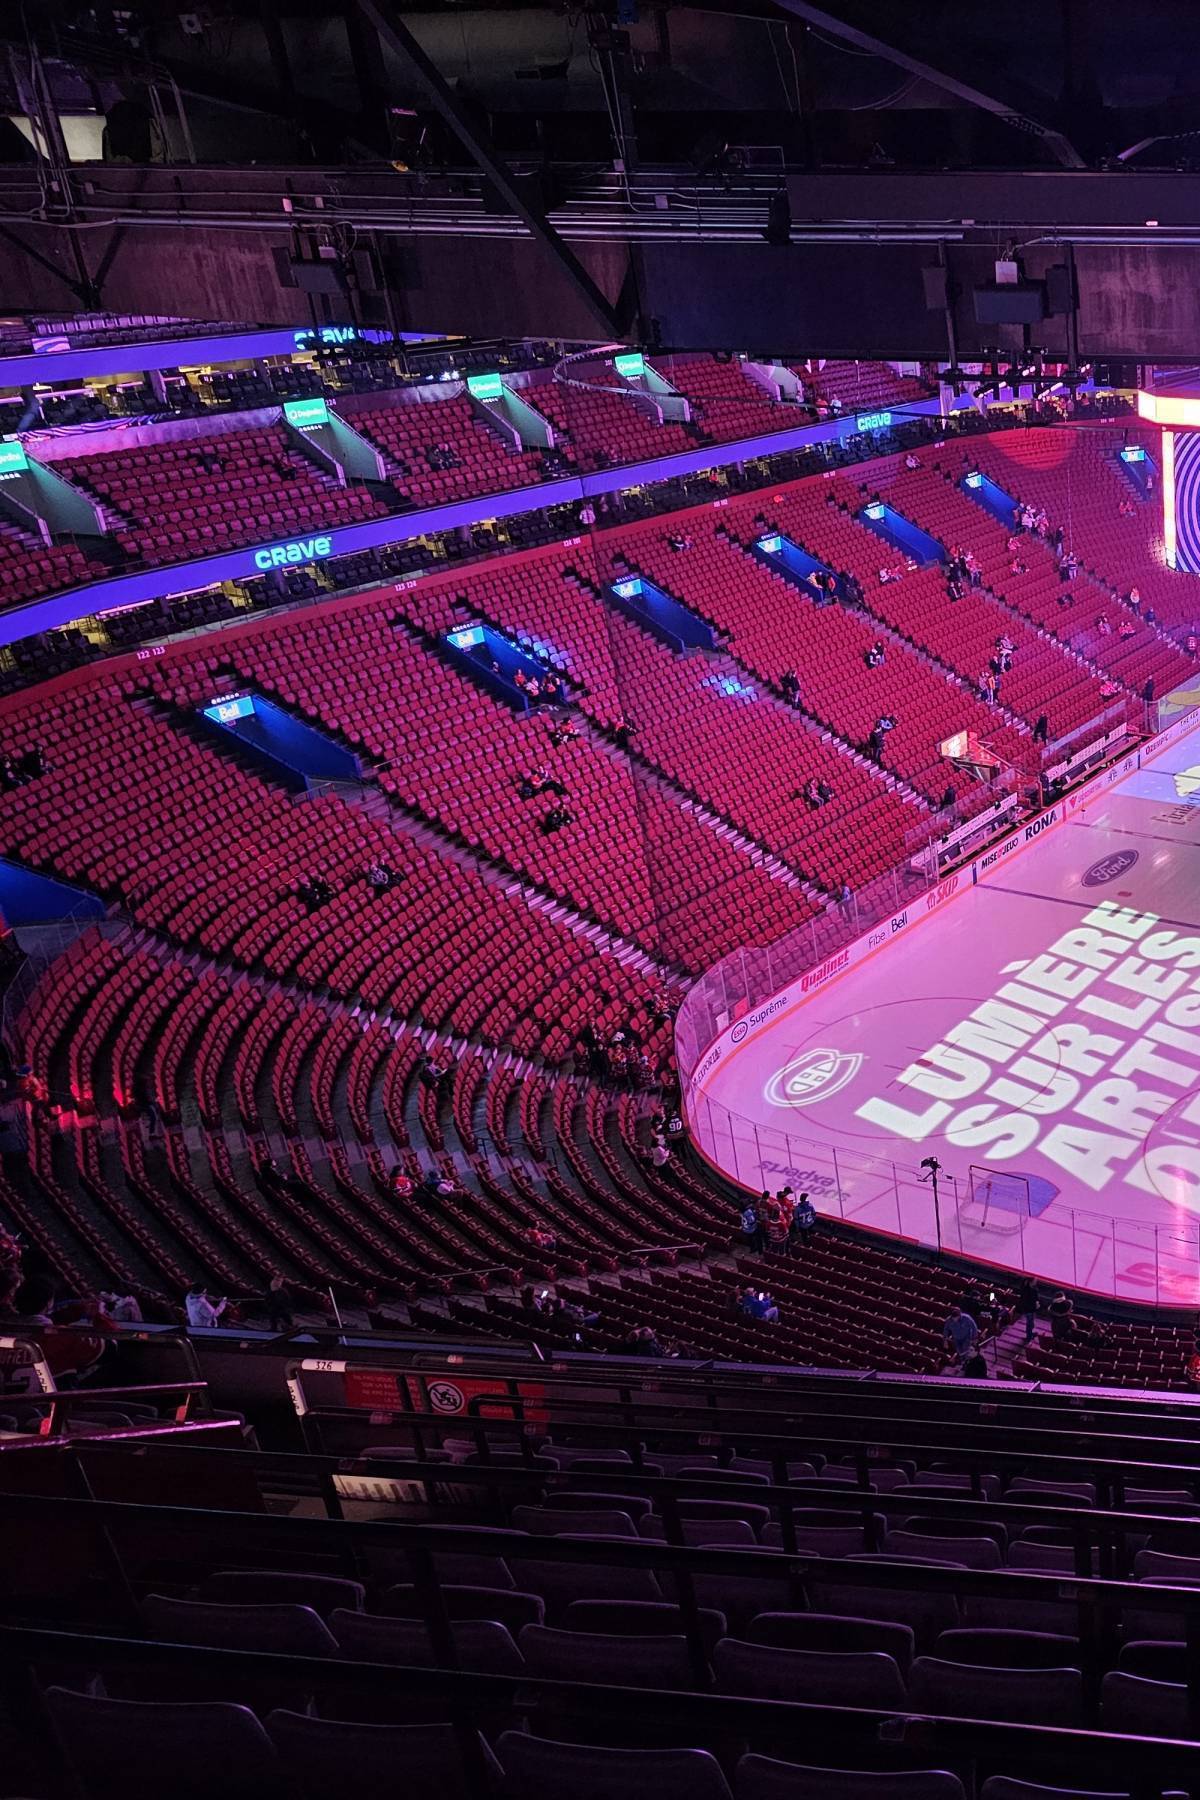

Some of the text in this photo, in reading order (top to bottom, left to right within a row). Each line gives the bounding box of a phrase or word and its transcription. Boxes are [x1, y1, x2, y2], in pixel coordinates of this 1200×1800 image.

[136, 646, 166, 660] 122 123
[217, 703, 240, 721] Bell
[1024, 810, 1058, 842] RONA
[1091, 855, 1132, 882] Ford
[936, 875, 959, 905] SKIP
[868, 910, 908, 950] Fibe Bell
[801, 949, 850, 993] Qualinet
[749, 995, 789, 1028] Suprême
[854, 901, 1160, 1143] LUMIÈRE
[945, 1022, 1125, 1160] SUR
[669, 1121, 682, 1132] 90
[315, 1360, 333, 1371] 326
